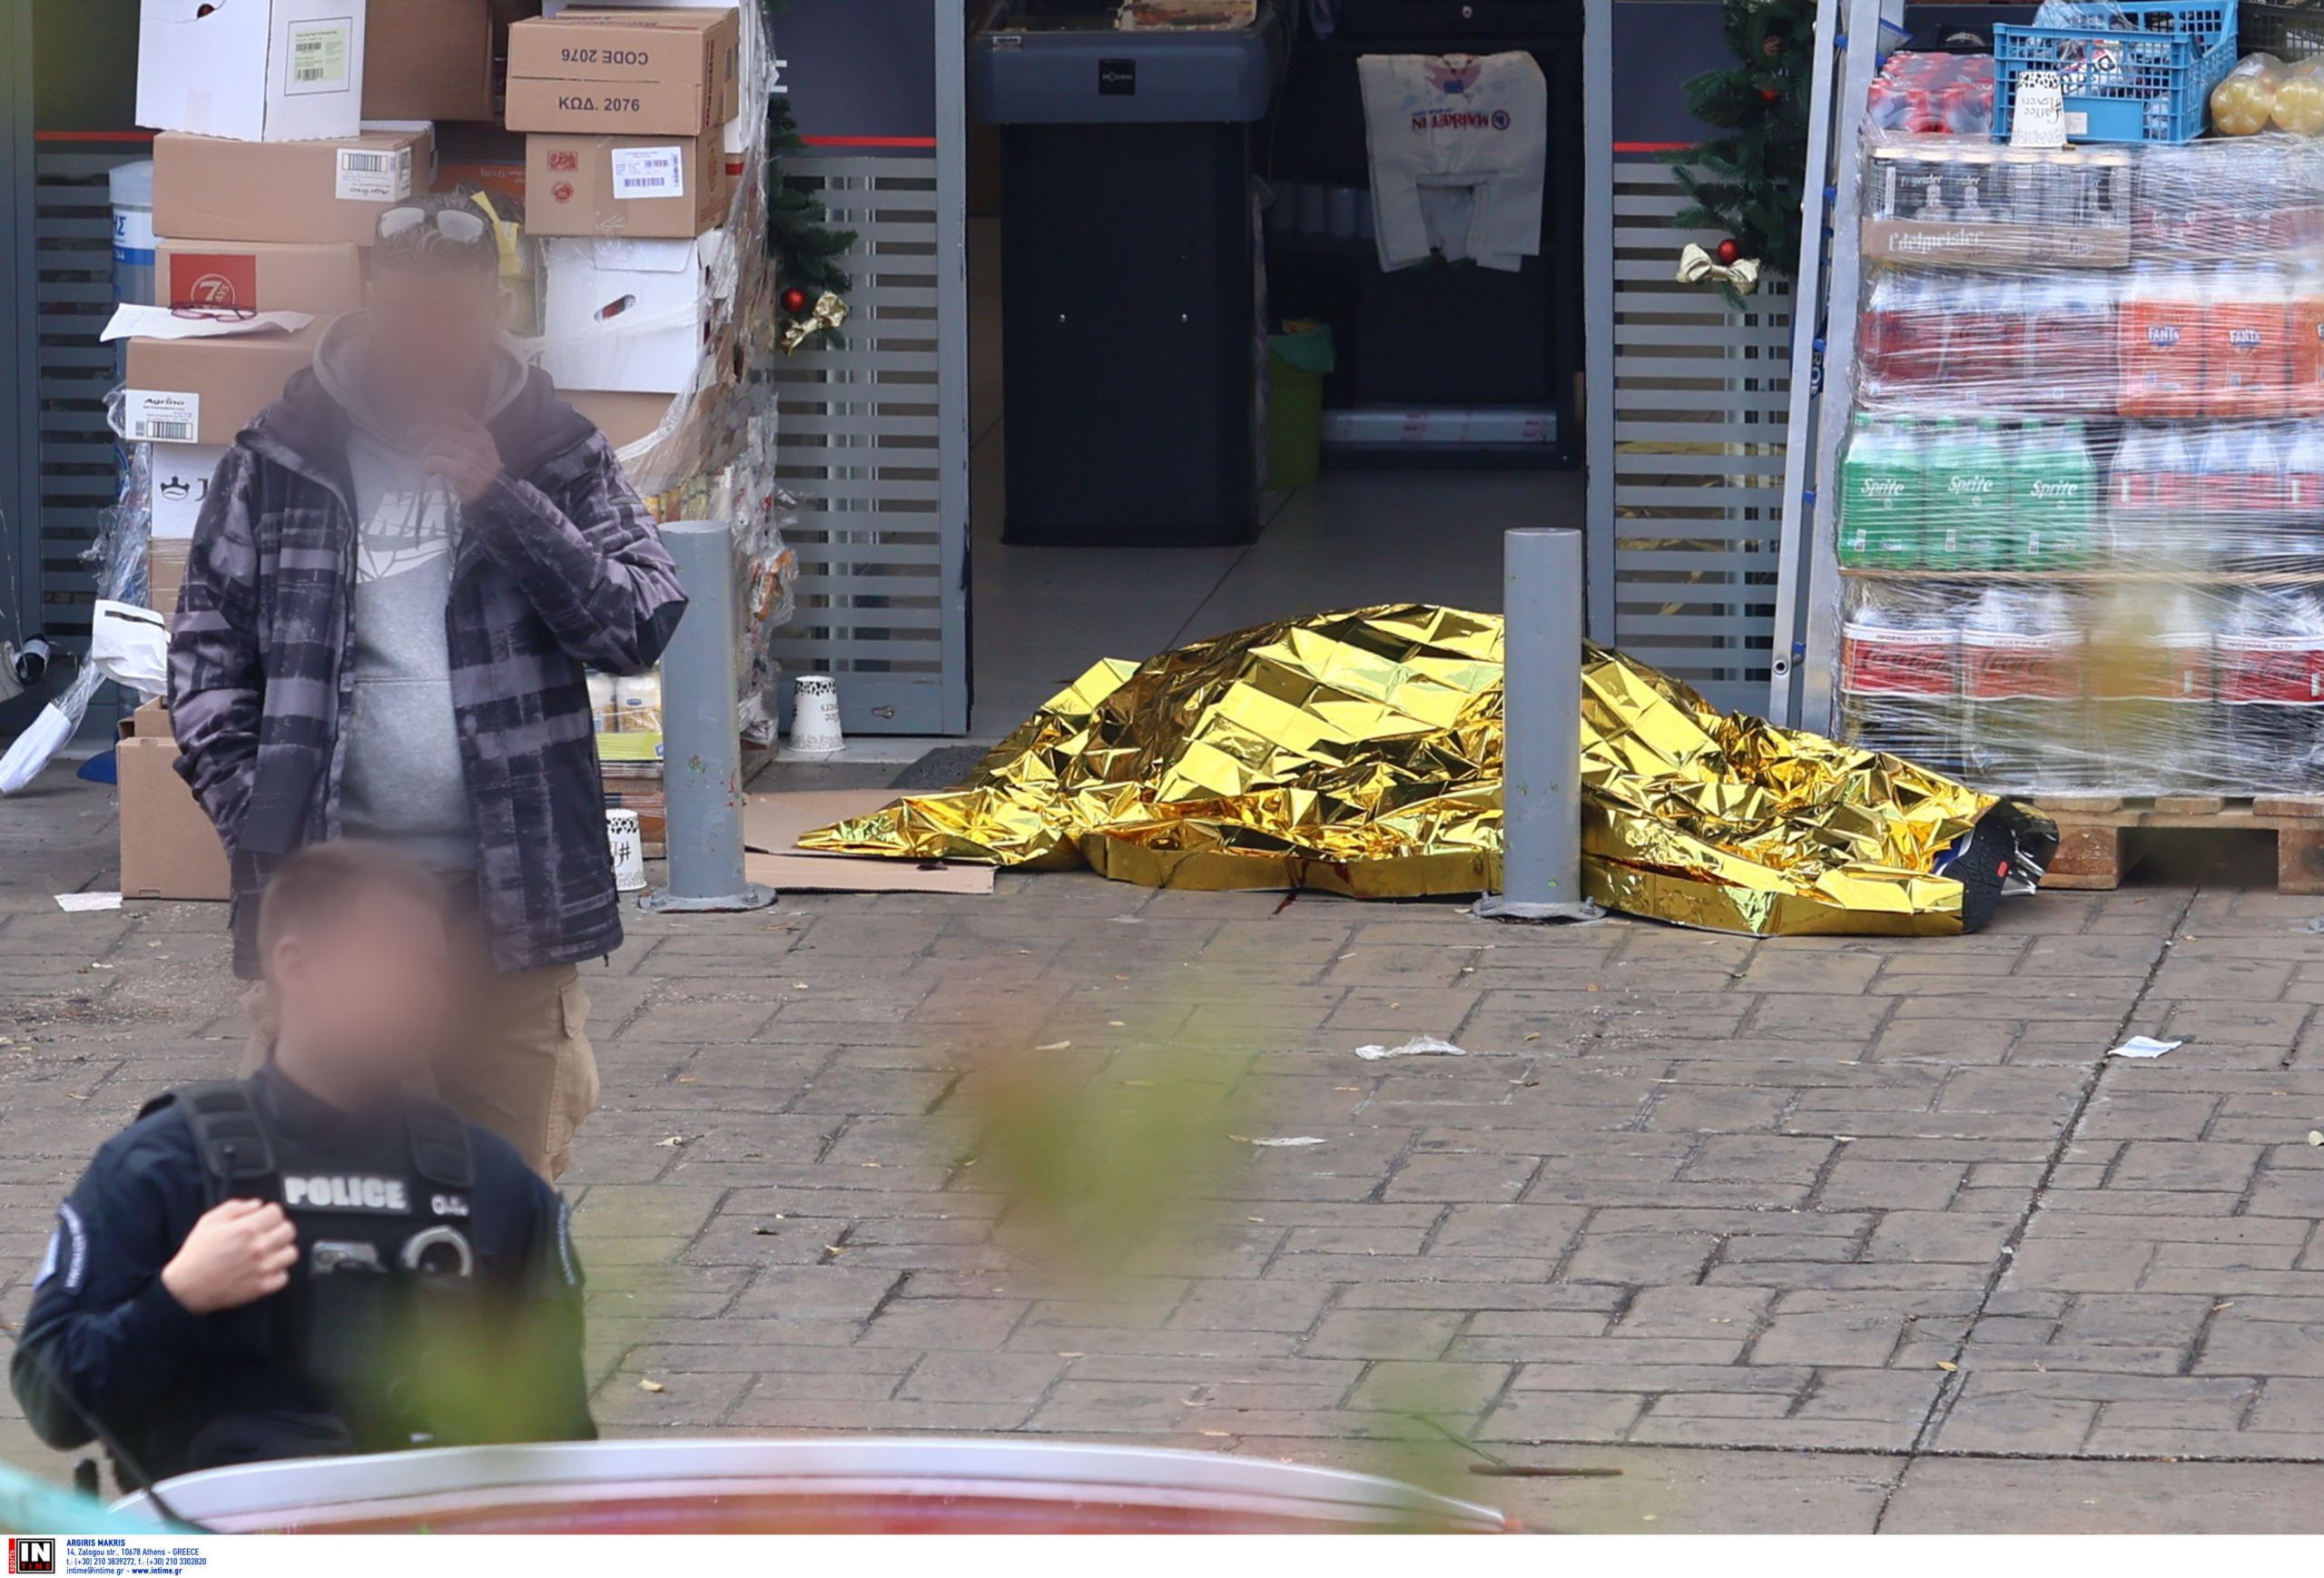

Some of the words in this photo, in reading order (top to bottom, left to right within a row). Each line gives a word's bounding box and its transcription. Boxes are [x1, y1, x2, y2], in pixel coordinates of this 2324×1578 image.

[561, 48, 597, 63] 2076
[602, 50, 648, 65] CODE
[604, 97, 640, 112] 2076
[2148, 326, 2180, 341] FANTA
[2229, 330, 2261, 344] FANTA
[144, 397, 184, 406] Agrino
[1861, 478, 1905, 497] Sprite
[1947, 476, 1994, 495] Sprite
[2030, 480, 2078, 499] Sprite
[284, 1177, 406, 1209] POLICE
